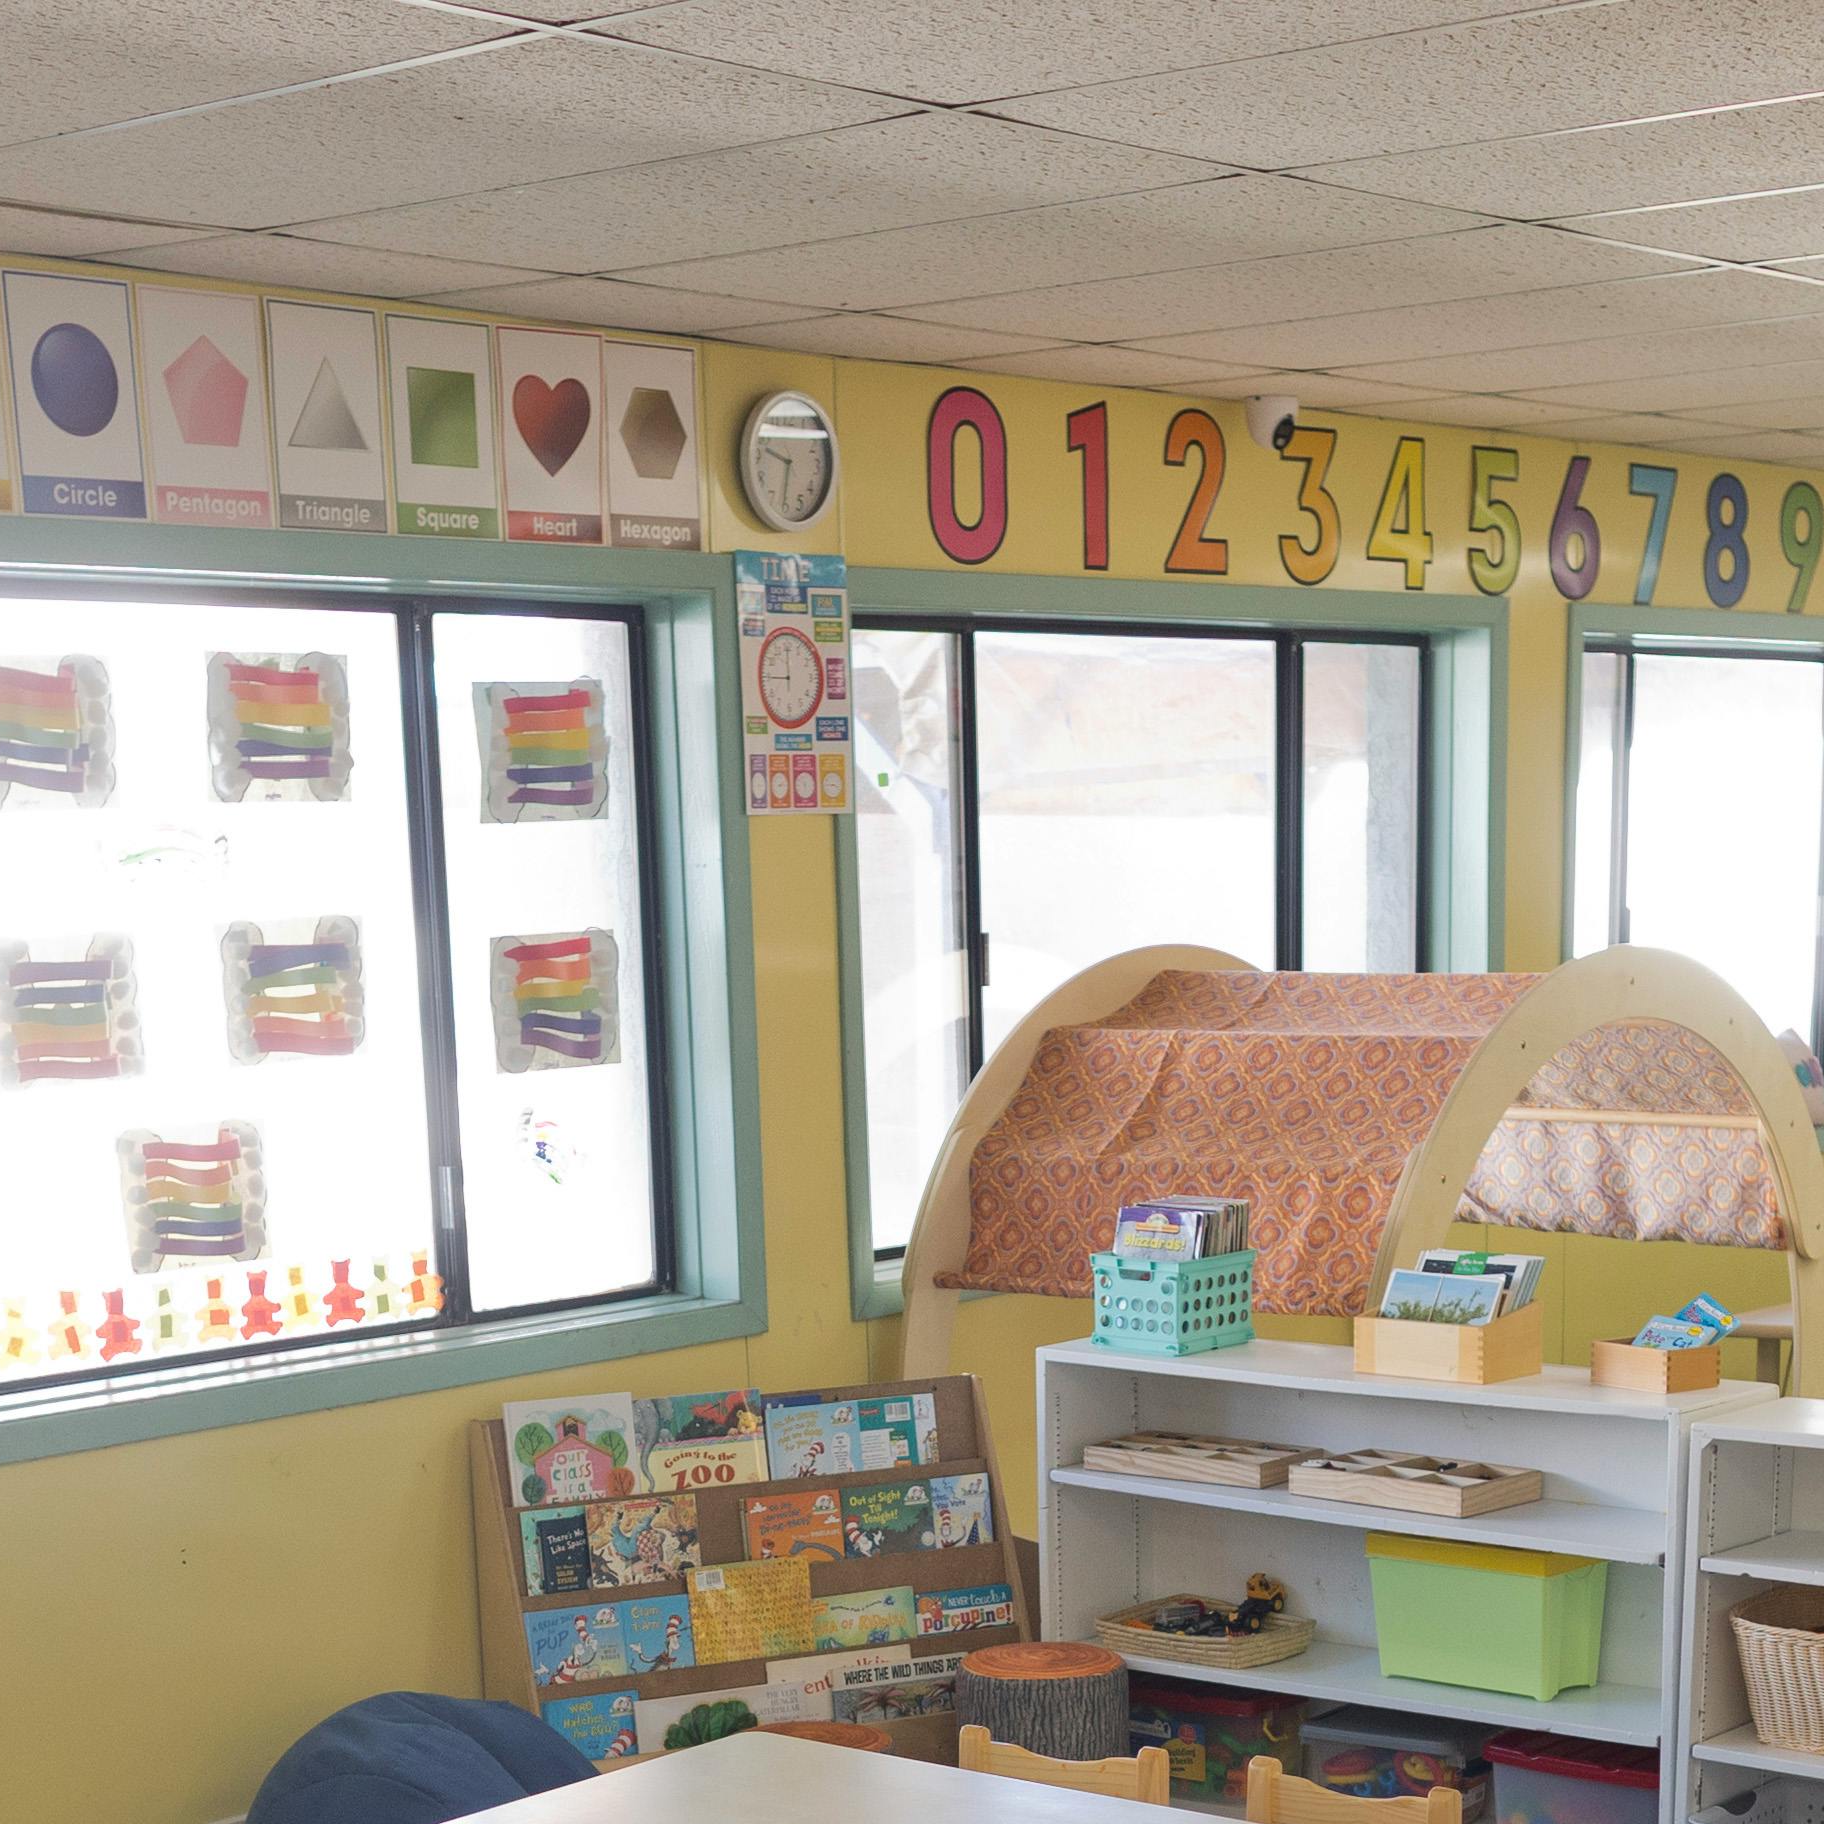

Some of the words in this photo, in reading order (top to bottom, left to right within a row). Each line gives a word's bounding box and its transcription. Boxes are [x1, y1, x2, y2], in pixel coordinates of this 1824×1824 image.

[53, 483, 117, 508] Circle
[165, 491, 262, 520] Pentagon
[926, 385, 1008, 565] 0
[1066, 402, 1109, 570] 1
[1162, 408, 1228, 574] 2
[1278, 426, 1341, 586] 3
[1366, 436, 1434, 590] 4
[1466, 445, 1521, 596] 5
[1548, 455, 1601, 600] 6
[1628, 463, 1678, 604] 7
[1702, 472, 1750, 608] 8
[1781, 481, 1824, 613] 9
[295, 501, 371, 526] Triangle
[416, 507, 479, 533] Square
[533, 516, 578, 538] Heart
[620, 520, 692, 544] Hexagon
[761, 557, 810, 582] TIME
[1124, 1233, 1185, 1251] Blizzards!
[664, 1451, 701, 1469] Going
[703, 1452, 716, 1461] to
[718, 1451, 737, 1461] the
[671, 1464, 735, 1490] ZOO
[850, 1496, 865, 1506] Out
[878, 1491, 900, 1504] Sight
[863, 1510, 898, 1524] Tonight!
[547, 1533, 573, 1544] There's
[551, 1544, 567, 1555] Like
[567, 1539, 586, 1550] Space
[947, 1595, 969, 1606] NEVER
[536, 1630, 569, 1655] PUP
[844, 1669, 873, 1685] WHERE
[875, 1667, 889, 1680] THE
[891, 1664, 911, 1678] WILD
[914, 1660, 944, 1676] THINGS
